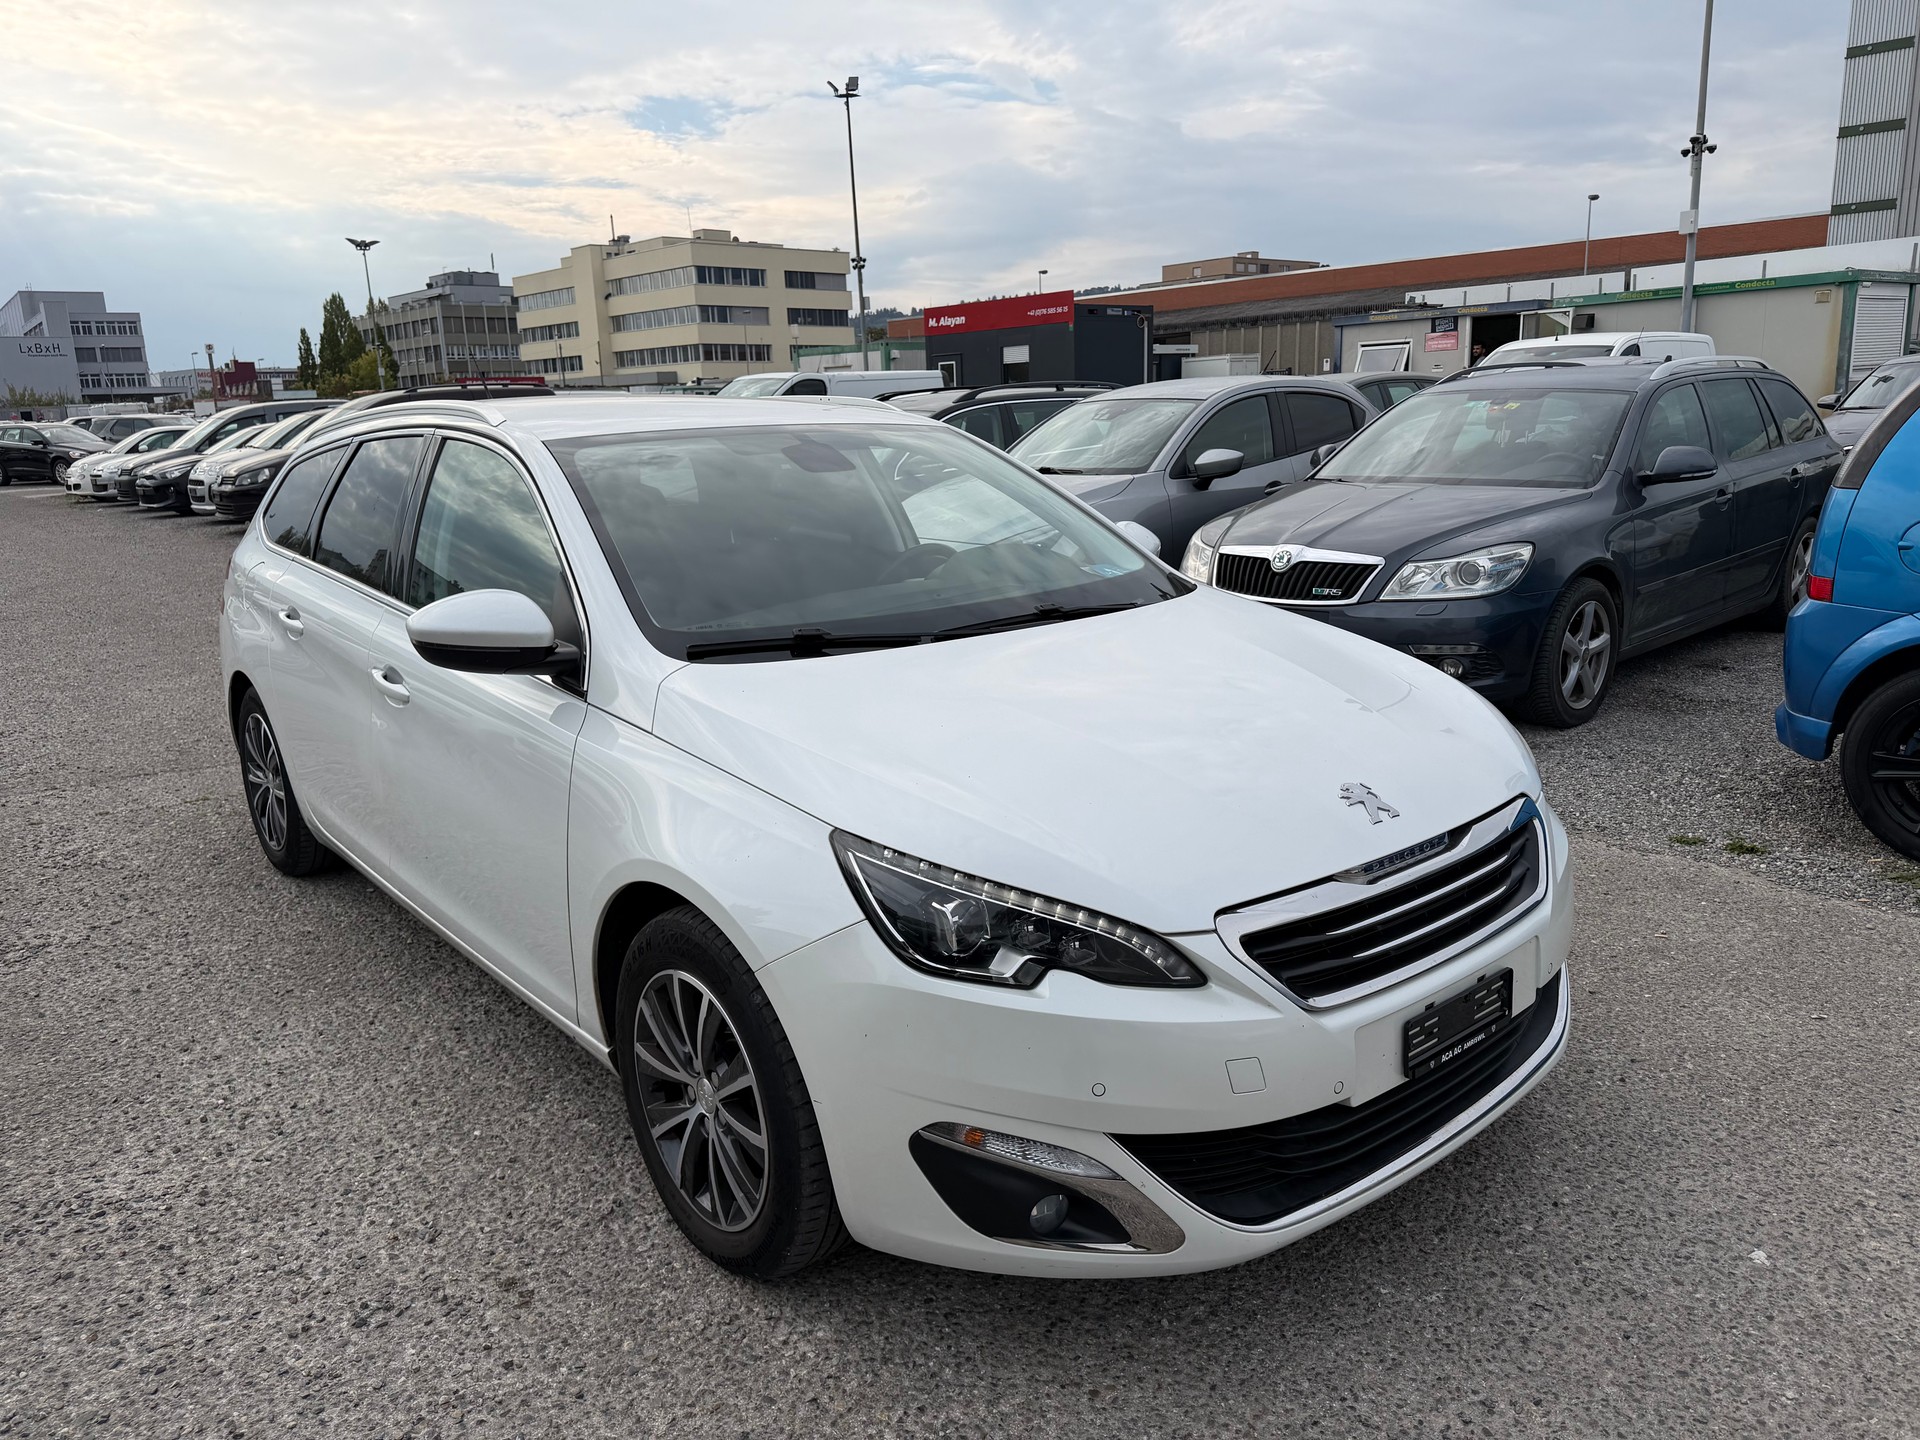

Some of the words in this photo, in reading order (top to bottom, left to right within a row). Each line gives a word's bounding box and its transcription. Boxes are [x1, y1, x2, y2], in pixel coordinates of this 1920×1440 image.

[1735, 279, 1775, 289] Condecta
[928, 318, 938, 328] M.
[939, 315, 966, 328] Alayan
[1372, 839, 1440, 871] PEUGEOT
[1441, 1050, 1453, 1063] ACA
[1453, 1045, 1462, 1056] AG
[1463, 1032, 1486, 1050] AMRISWIL
